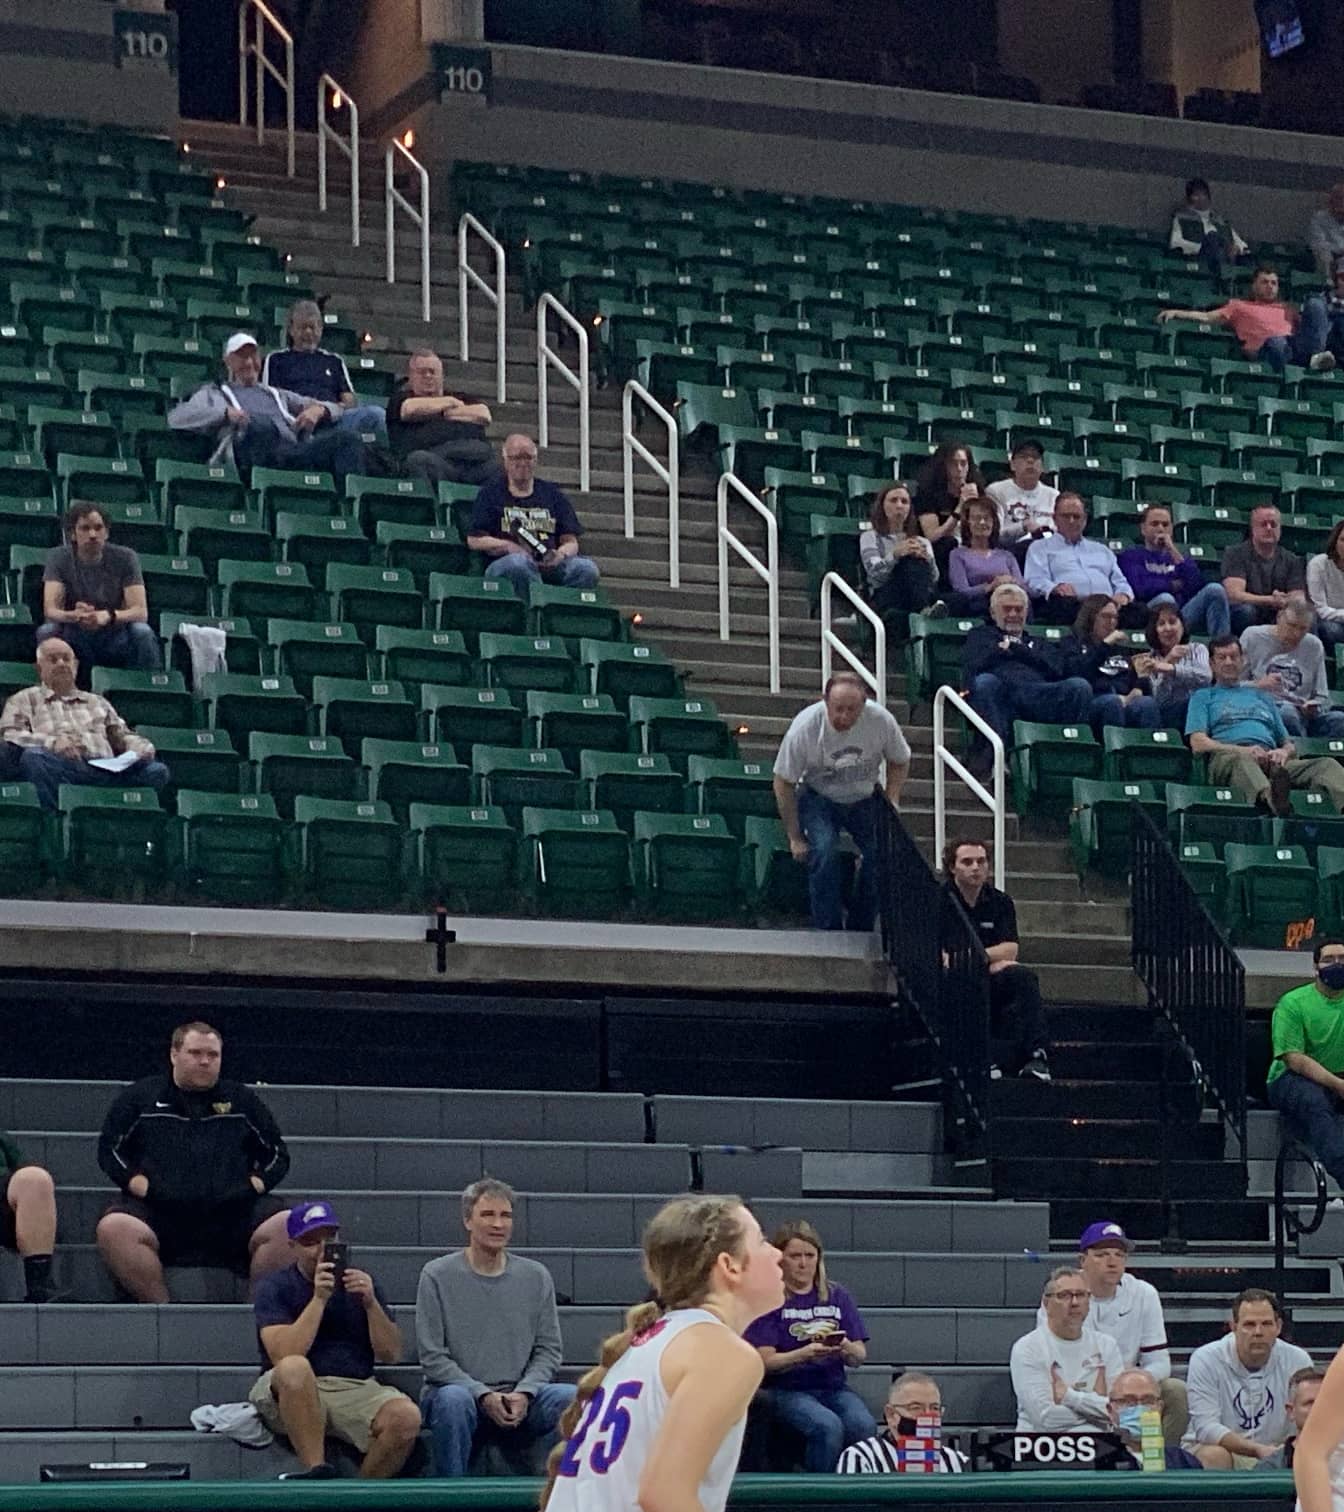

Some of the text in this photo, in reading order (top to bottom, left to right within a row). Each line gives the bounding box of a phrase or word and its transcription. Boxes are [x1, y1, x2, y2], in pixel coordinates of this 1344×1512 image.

[124, 33, 168, 58] 110
[445, 66, 483, 92] 110
[559, 1379, 644, 1478] 25
[1014, 1436, 1095, 1463] POSS
